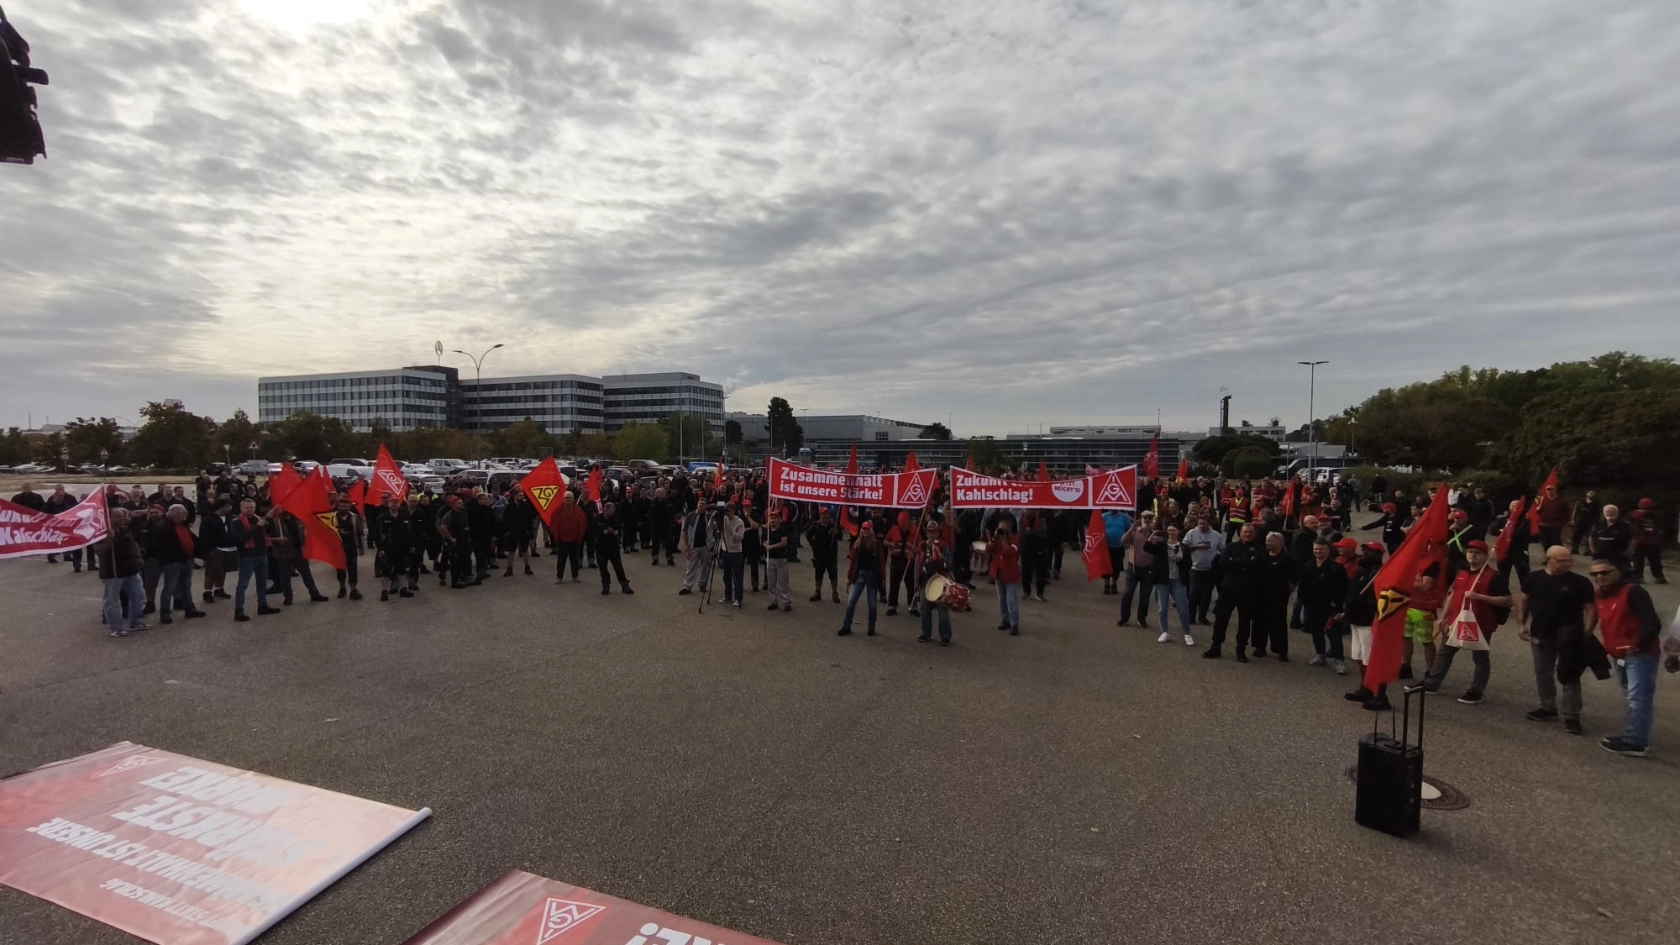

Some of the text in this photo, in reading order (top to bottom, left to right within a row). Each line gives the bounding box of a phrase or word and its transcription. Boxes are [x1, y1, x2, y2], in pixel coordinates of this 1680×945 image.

[781, 467, 883, 487] Zusammenhalt
[780, 480, 883, 500] ist unsere Stärke!
[956, 488, 1034, 503] Kahlschlag!
[25, 817, 116, 850] UNSERE
[91, 840, 148, 861] IST
